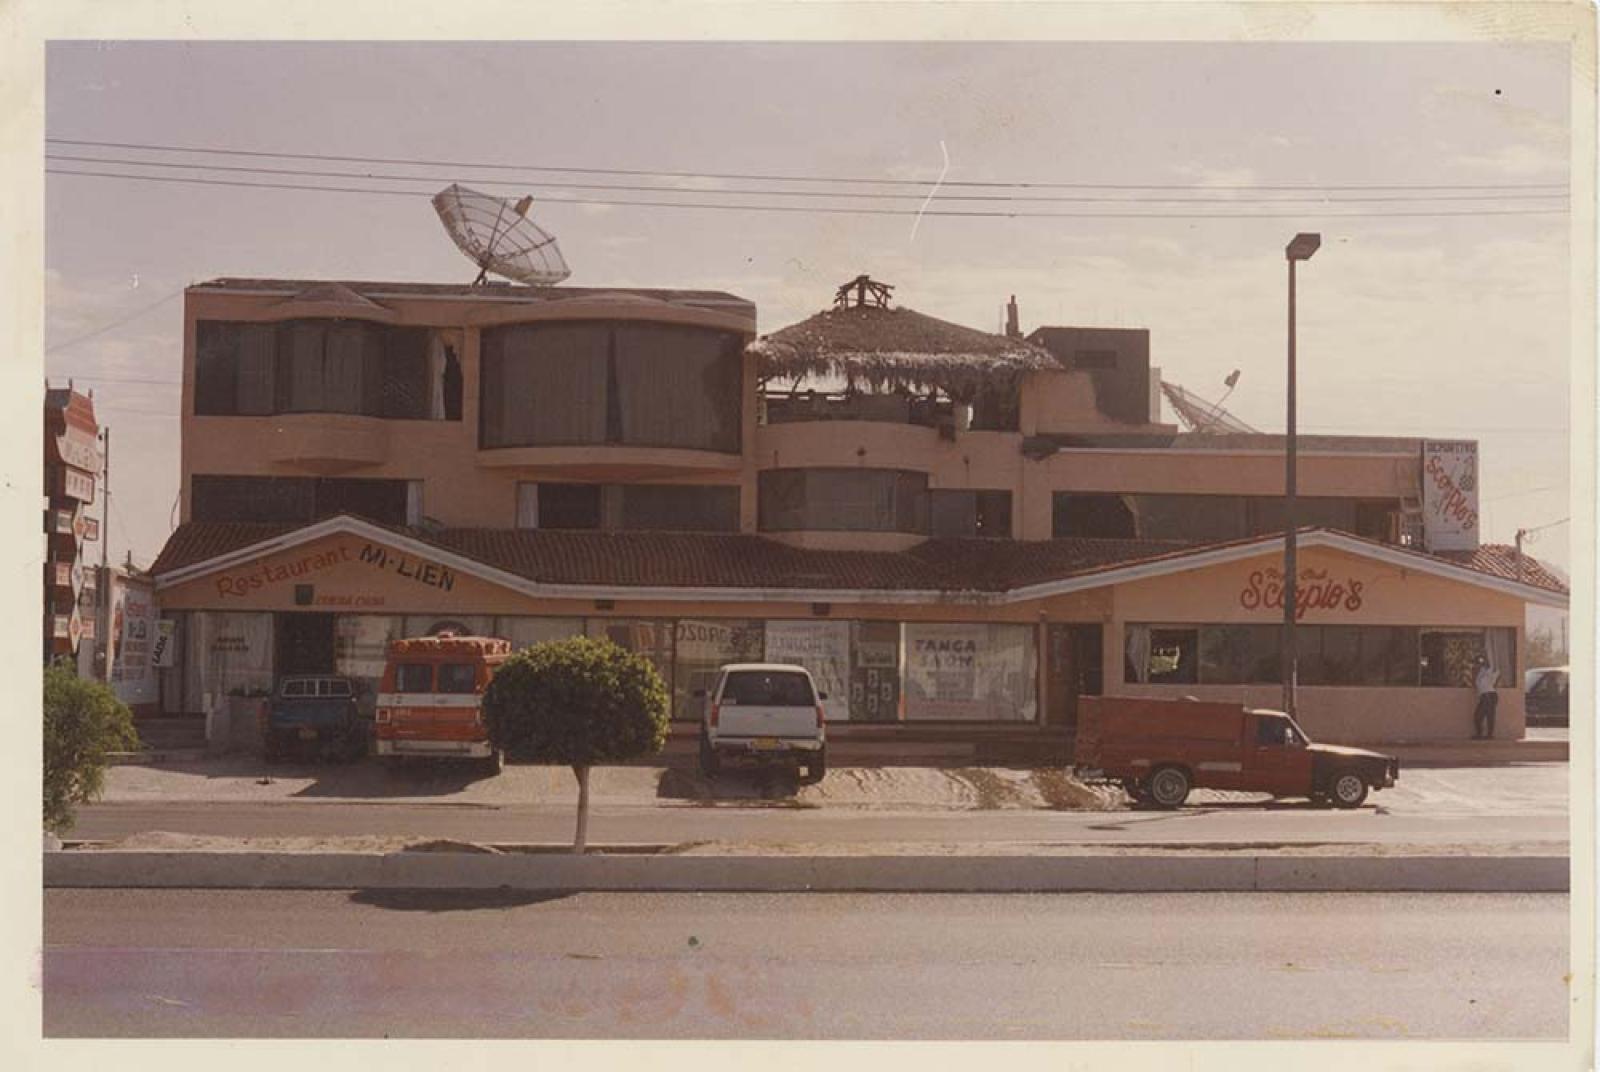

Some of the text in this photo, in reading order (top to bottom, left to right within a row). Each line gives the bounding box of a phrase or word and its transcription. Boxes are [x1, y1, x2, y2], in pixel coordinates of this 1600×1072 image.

[216, 545, 352, 599] Restaurant
[1240, 570, 1364, 618] Scrpio's
[915, 639, 976, 654] TANGA
